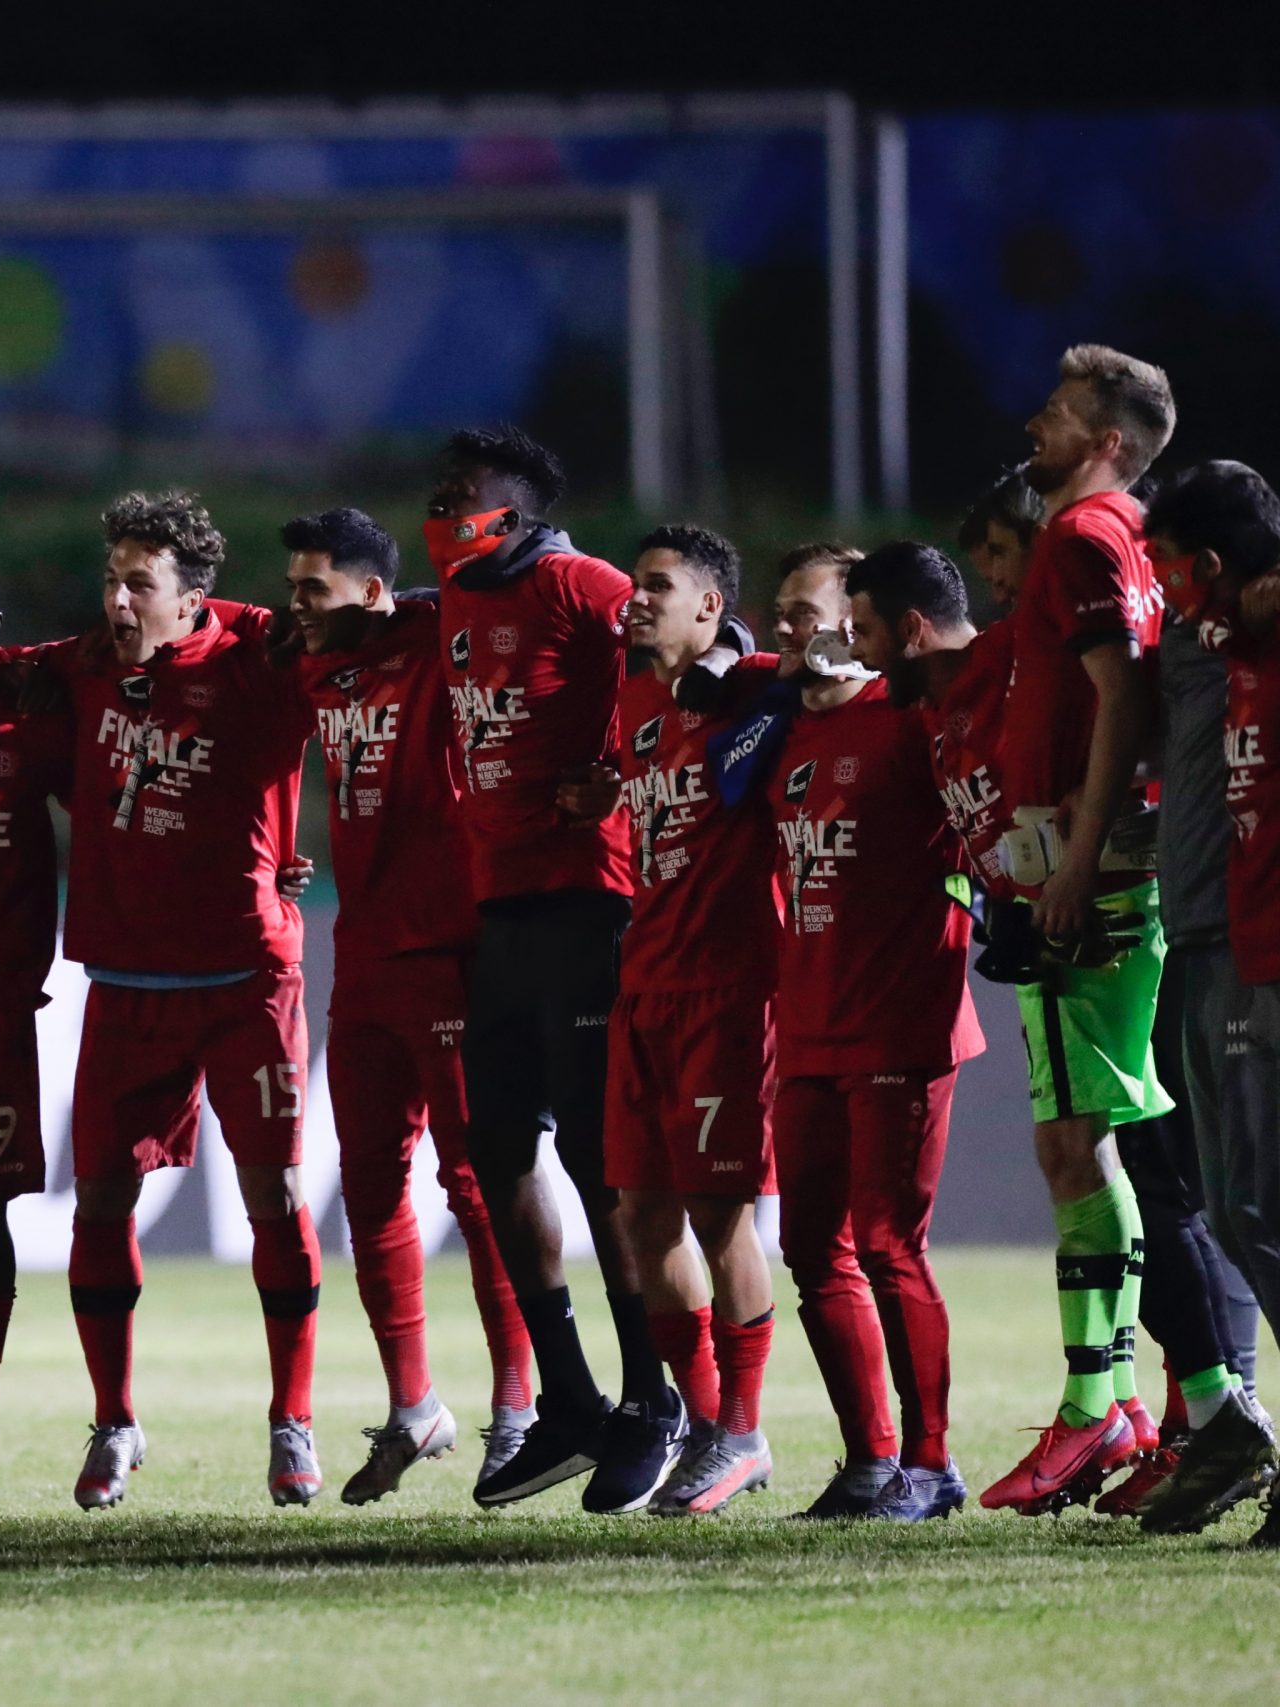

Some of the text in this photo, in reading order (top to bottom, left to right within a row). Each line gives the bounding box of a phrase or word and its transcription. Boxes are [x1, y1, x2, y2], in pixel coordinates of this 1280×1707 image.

[318, 703, 400, 745] FINALE
[97, 708, 215, 773] FINALE
[484, 768, 512, 780] BERLIN
[479, 780, 498, 790] 2020
[621, 764, 709, 815] FINALE
[143, 823, 166, 836] 2020
[144, 815, 186, 831] IN BERLIN
[660, 868, 677, 880] 2020
[804, 923, 824, 933] 2020
[431, 1019, 465, 1033] JAKO
[574, 1015, 609, 1028] JAKO
[441, 1033, 454, 1046] M
[1225, 1042, 1248, 1055] JAK
[872, 1073, 906, 1085] JAKO
[253, 1063, 303, 1118] 15
[694, 1096, 723, 1153] 7
[711, 1160, 744, 1173] JAKO
